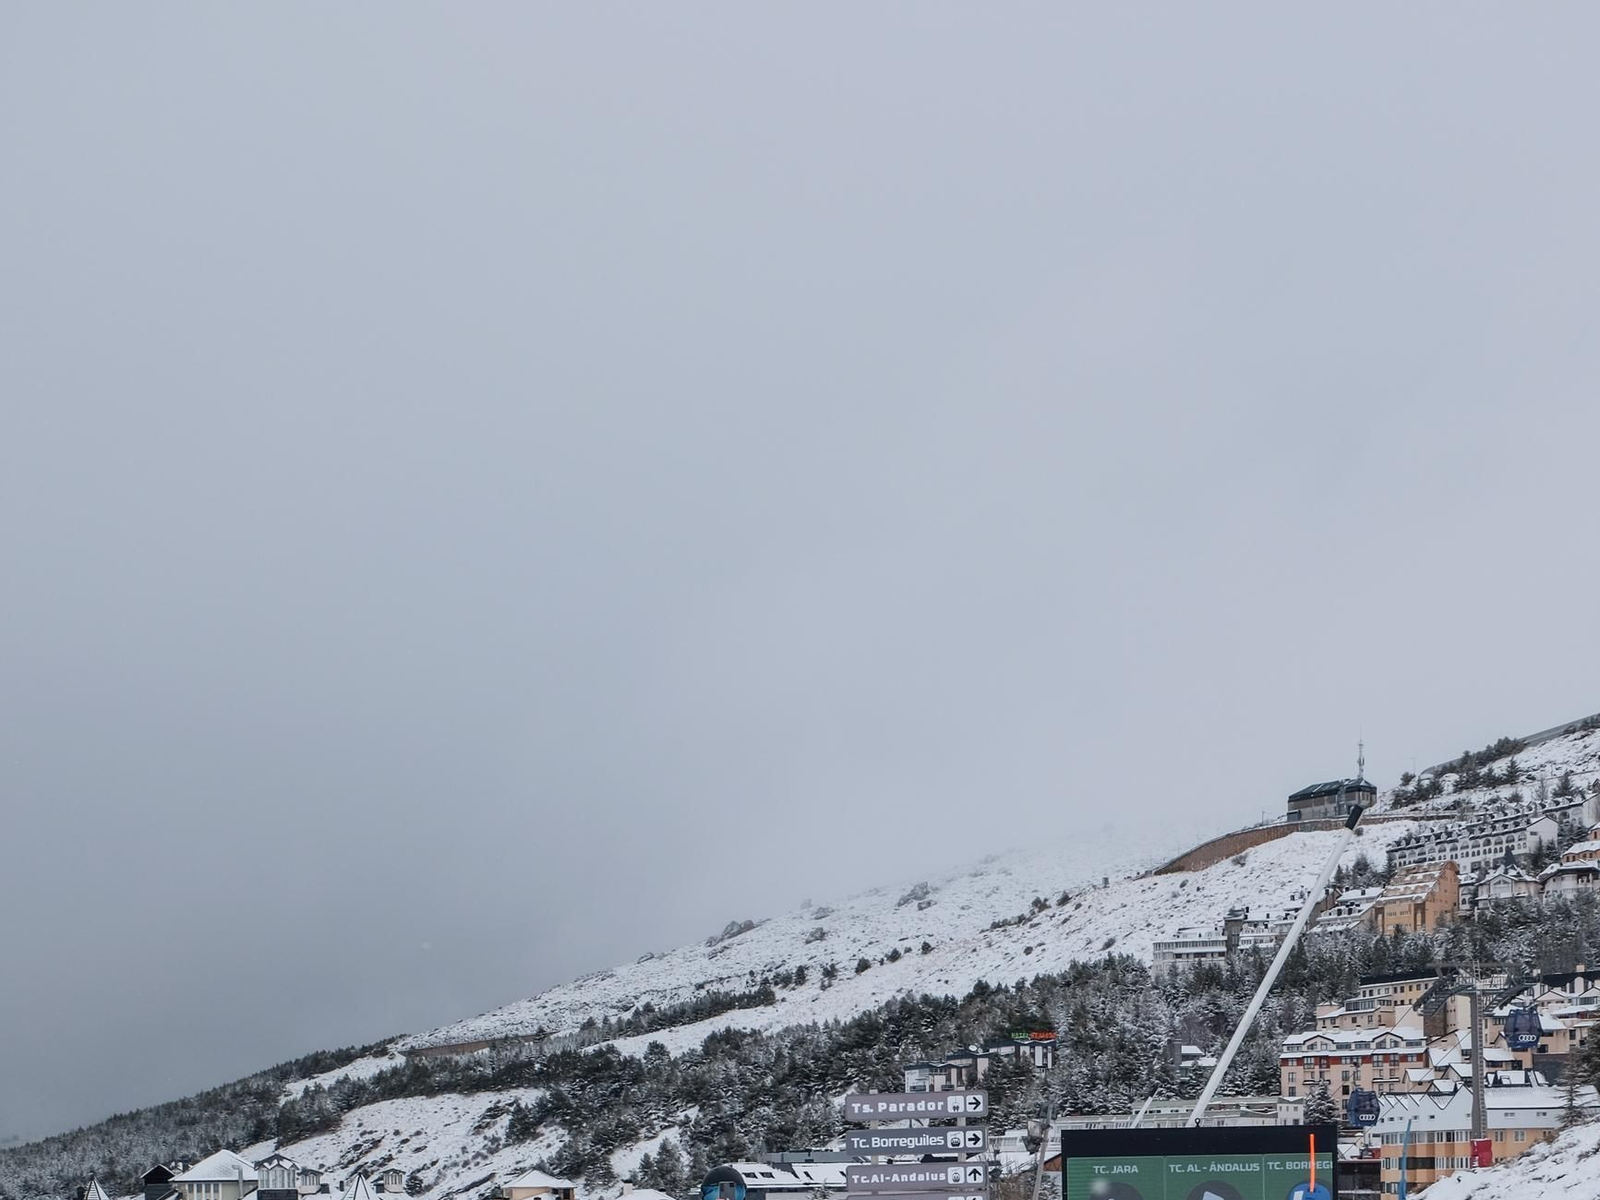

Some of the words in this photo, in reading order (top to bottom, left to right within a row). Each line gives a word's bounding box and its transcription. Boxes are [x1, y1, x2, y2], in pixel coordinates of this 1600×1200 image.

[852, 1103, 874, 1113] Ts.
[878, 1100, 944, 1112] Parador
[851, 1138, 869, 1148] Tc.
[872, 1134, 944, 1149] Borreguiles
[1093, 1165, 1109, 1174] TC.
[1111, 1165, 1139, 1174] JARA
[1168, 1164, 1185, 1173] TC.
[1187, 1164, 1201, 1172] AL
[1267, 1161, 1284, 1170] TC.
